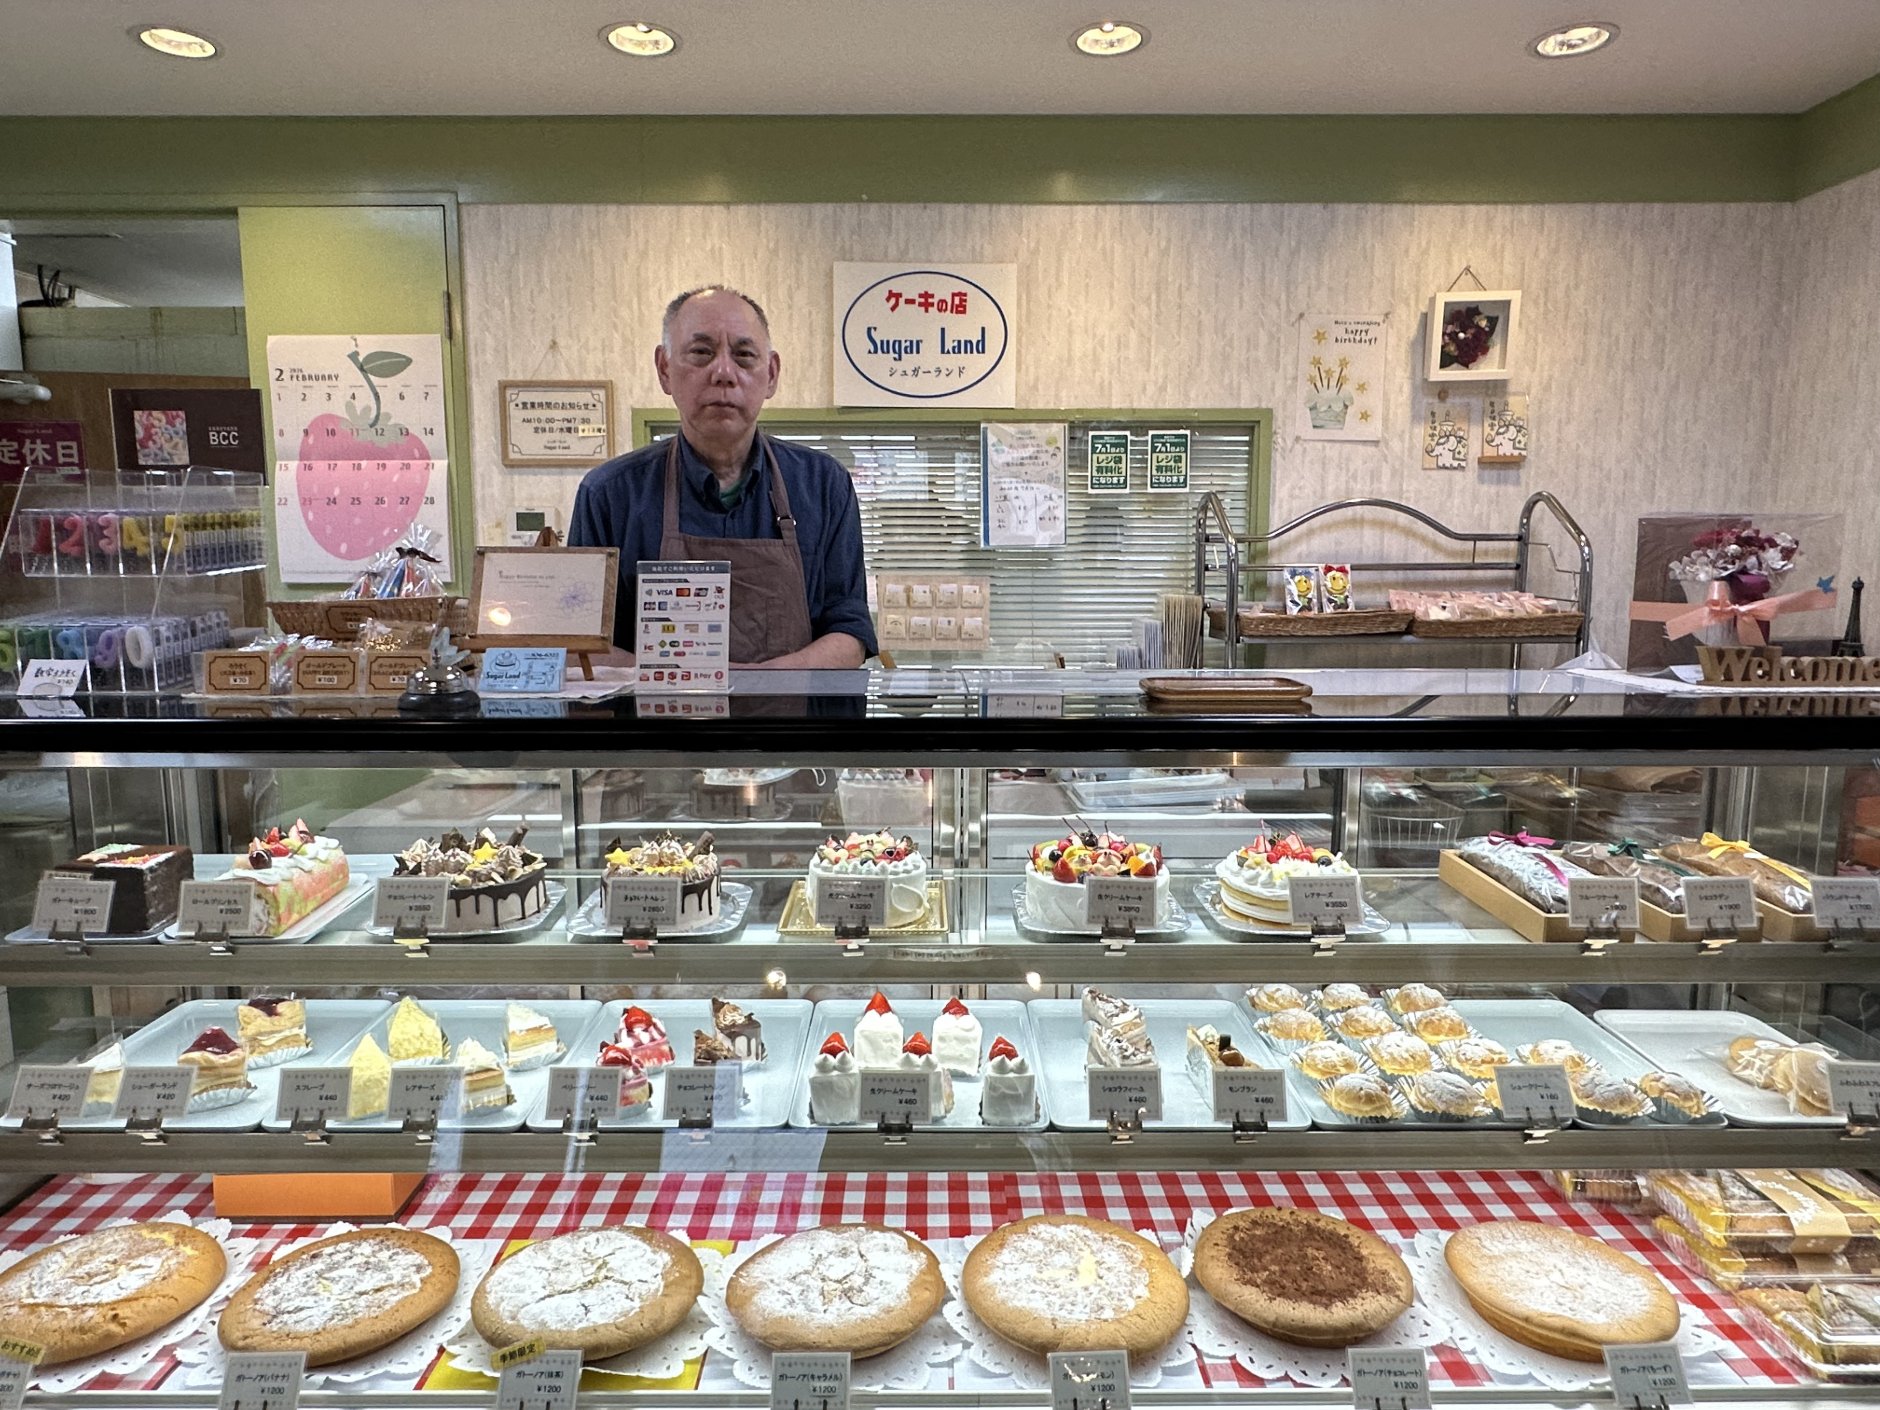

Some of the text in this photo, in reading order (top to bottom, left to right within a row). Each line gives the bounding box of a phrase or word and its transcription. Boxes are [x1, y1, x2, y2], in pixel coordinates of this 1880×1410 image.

[885, 289, 968, 315] ケーキの店
[1345, 328, 1370, 336] happy
[866, 326, 986, 362] Sugar Land
[275, 368, 285, 382] 2
[888, 366, 966, 378] シュガーランド
[289, 373, 340, 381] FEBRUARY
[301, 393, 307, 401] 2
[326, 393, 332, 401] 3
[351, 393, 356, 401] 4
[399, 393, 405, 401] 6
[424, 393, 430, 401] 7
[302, 428, 309, 437] 9
[325, 428, 336, 437] 10
[374, 428, 385, 437] 12
[399, 428, 410, 437] 13
[423, 428, 434, 437] 14
[209, 431, 239, 445] BCC
[0, 438, 79, 465] 定休日
[1094, 443, 1125, 453] 7月1日より
[1154, 443, 1185, 452] 7月1日より
[1096, 455, 1122, 464] レジ袋
[1156, 455, 1182, 463] レジ袋
[279, 463, 435, 471] 15 16 17 18 19 20 21
[1095, 466, 1122, 474] 有料化
[1155, 465, 1182, 474] 有料化
[1092, 476, 1125, 484] になります
[277, 497, 288, 506] 22
[326, 497, 337, 506] 24
[350, 497, 361, 506] 25
[375, 497, 386, 506] 26
[399, 497, 410, 506] 27
[424, 497, 435, 506] 28
[1696, 646, 1880, 683] Welcome
[486, 671, 521, 680] Sugar Land
[405, 1083, 436, 1091] レアチーズ
[869, 1087, 918, 1095] 生クリームケーキ
[1228, 1085, 1257, 1093] モンブラン
[499, 1343, 537, 1363] 季節限定
[516, 1370, 564, 1379] ガトーノア(抹茶)
[778, 1372, 843, 1383] ガトーノア(キャラメル)
[1356, 1368, 1422, 1378] ガトーノア(チョコレート)
[1394, 1381, 1419, 1390] ¥1200
[1652, 1377, 1677, 1386] ¥1200
[260, 1386, 285, 1395] ¥1200
[537, 1385, 561, 1393] ¥1200
[811, 1385, 836, 1394] ¥1200
[1090, 1384, 1115, 1392] ¥1200
